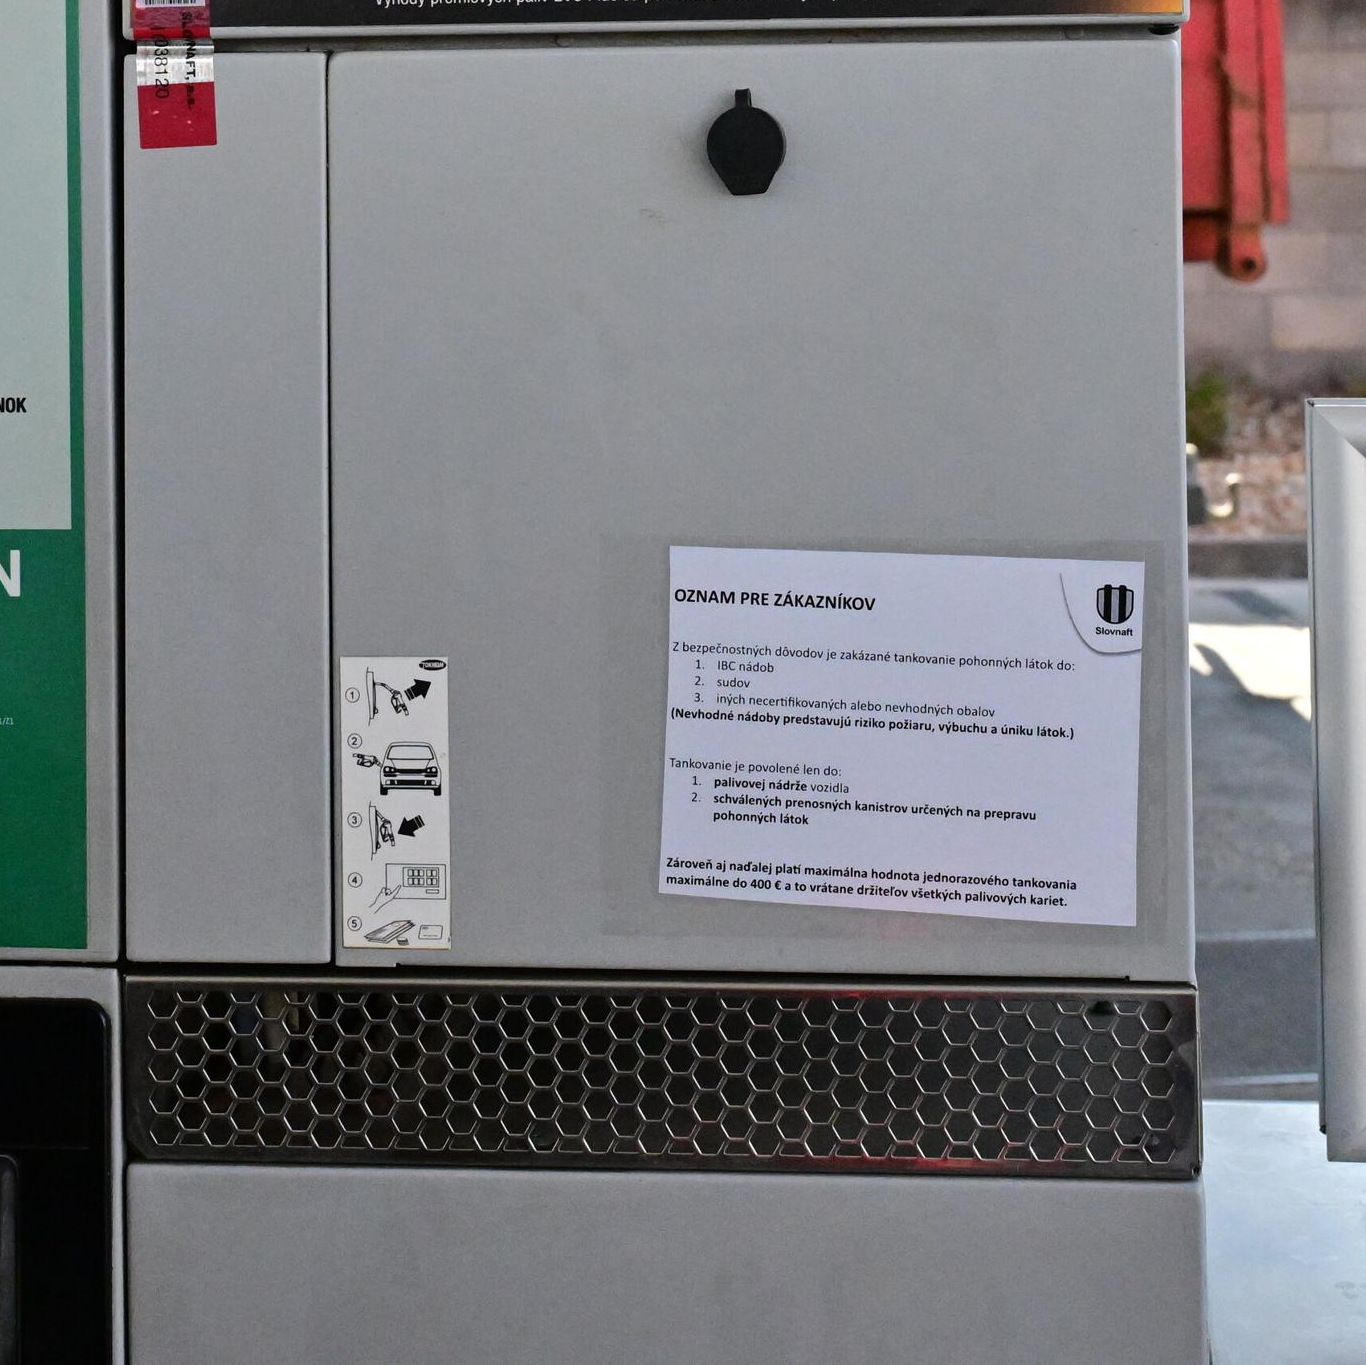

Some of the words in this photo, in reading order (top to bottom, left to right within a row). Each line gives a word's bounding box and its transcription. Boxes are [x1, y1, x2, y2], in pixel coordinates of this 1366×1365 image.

[674, 588, 735, 604] OZNAM
[740, 591, 768, 605] PRE
[773, 590, 875, 610] ZÁKAZNÍKOV
[1095, 626, 1132, 636] Slovnaft
[671, 707, 734, 721] (Nevhodné
[737, 711, 781, 726] nádoby
[784, 714, 851, 728] predstavujú
[854, 717, 886, 728] riziko
[888, 719, 935, 733] požiaru,
[938, 721, 988, 735] výbuchu
[991, 726, 998, 735] a
[1000, 724, 1034, 736] úniku
[1036, 725, 1074, 740] látok.)
